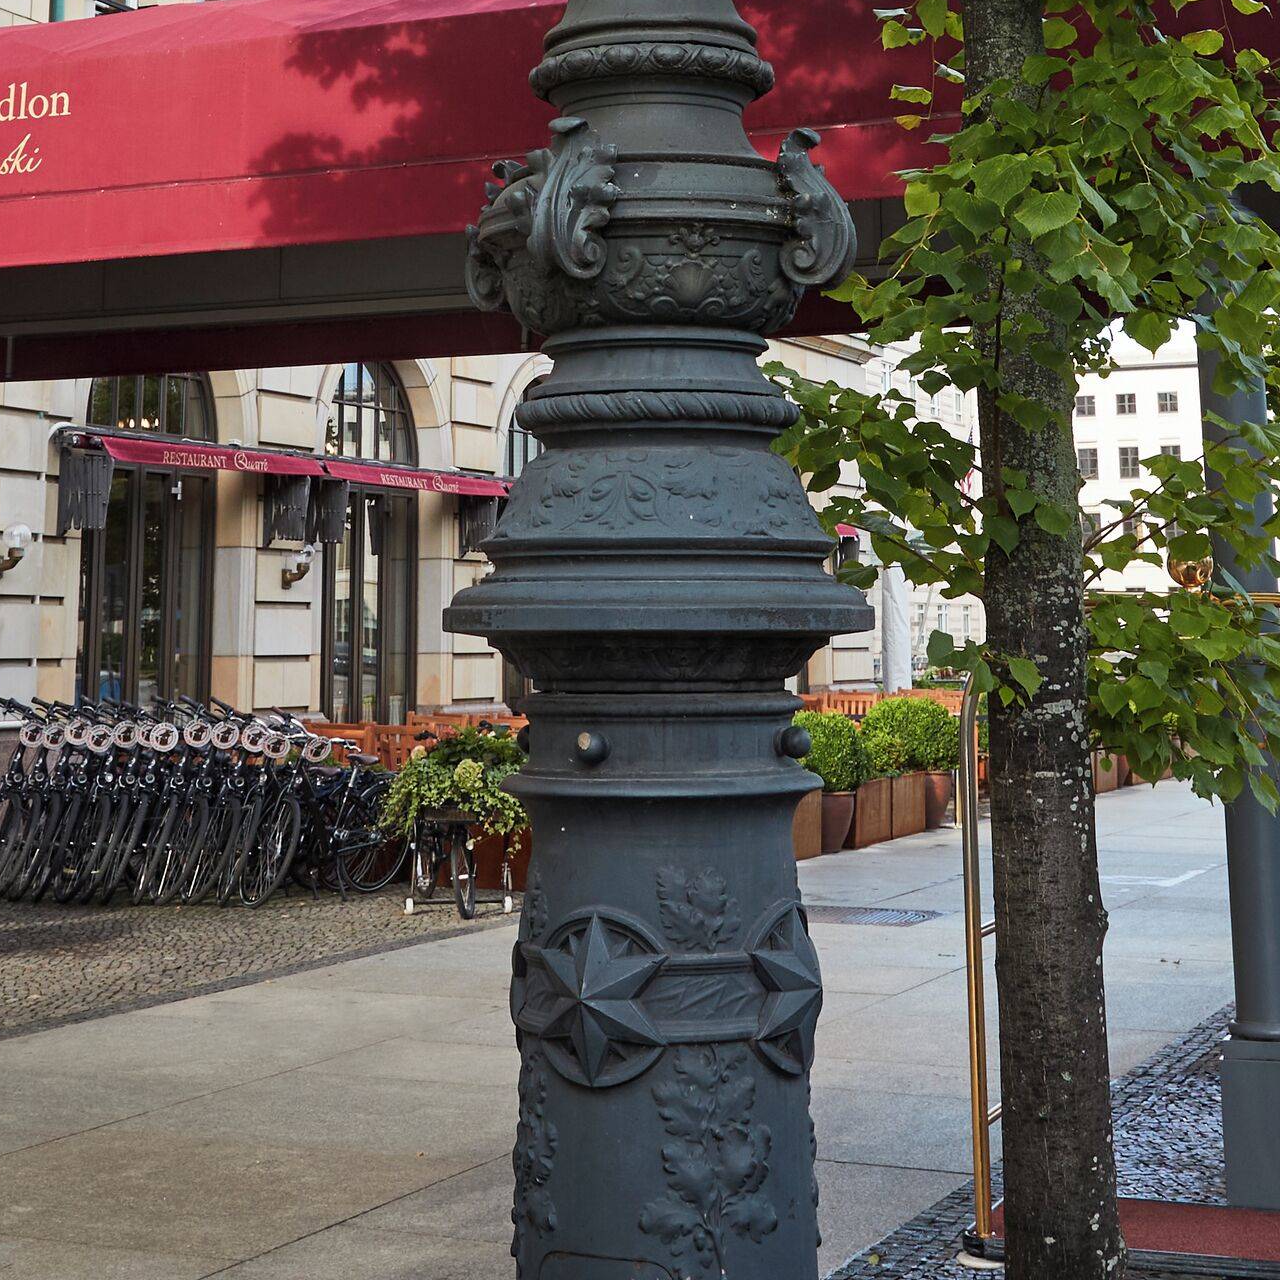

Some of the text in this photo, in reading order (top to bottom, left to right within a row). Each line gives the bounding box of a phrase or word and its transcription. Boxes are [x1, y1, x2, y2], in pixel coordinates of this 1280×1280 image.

[162, 450, 269, 472] RESTAURANT Quarré
[380, 473, 428, 489] RESTAURANT
